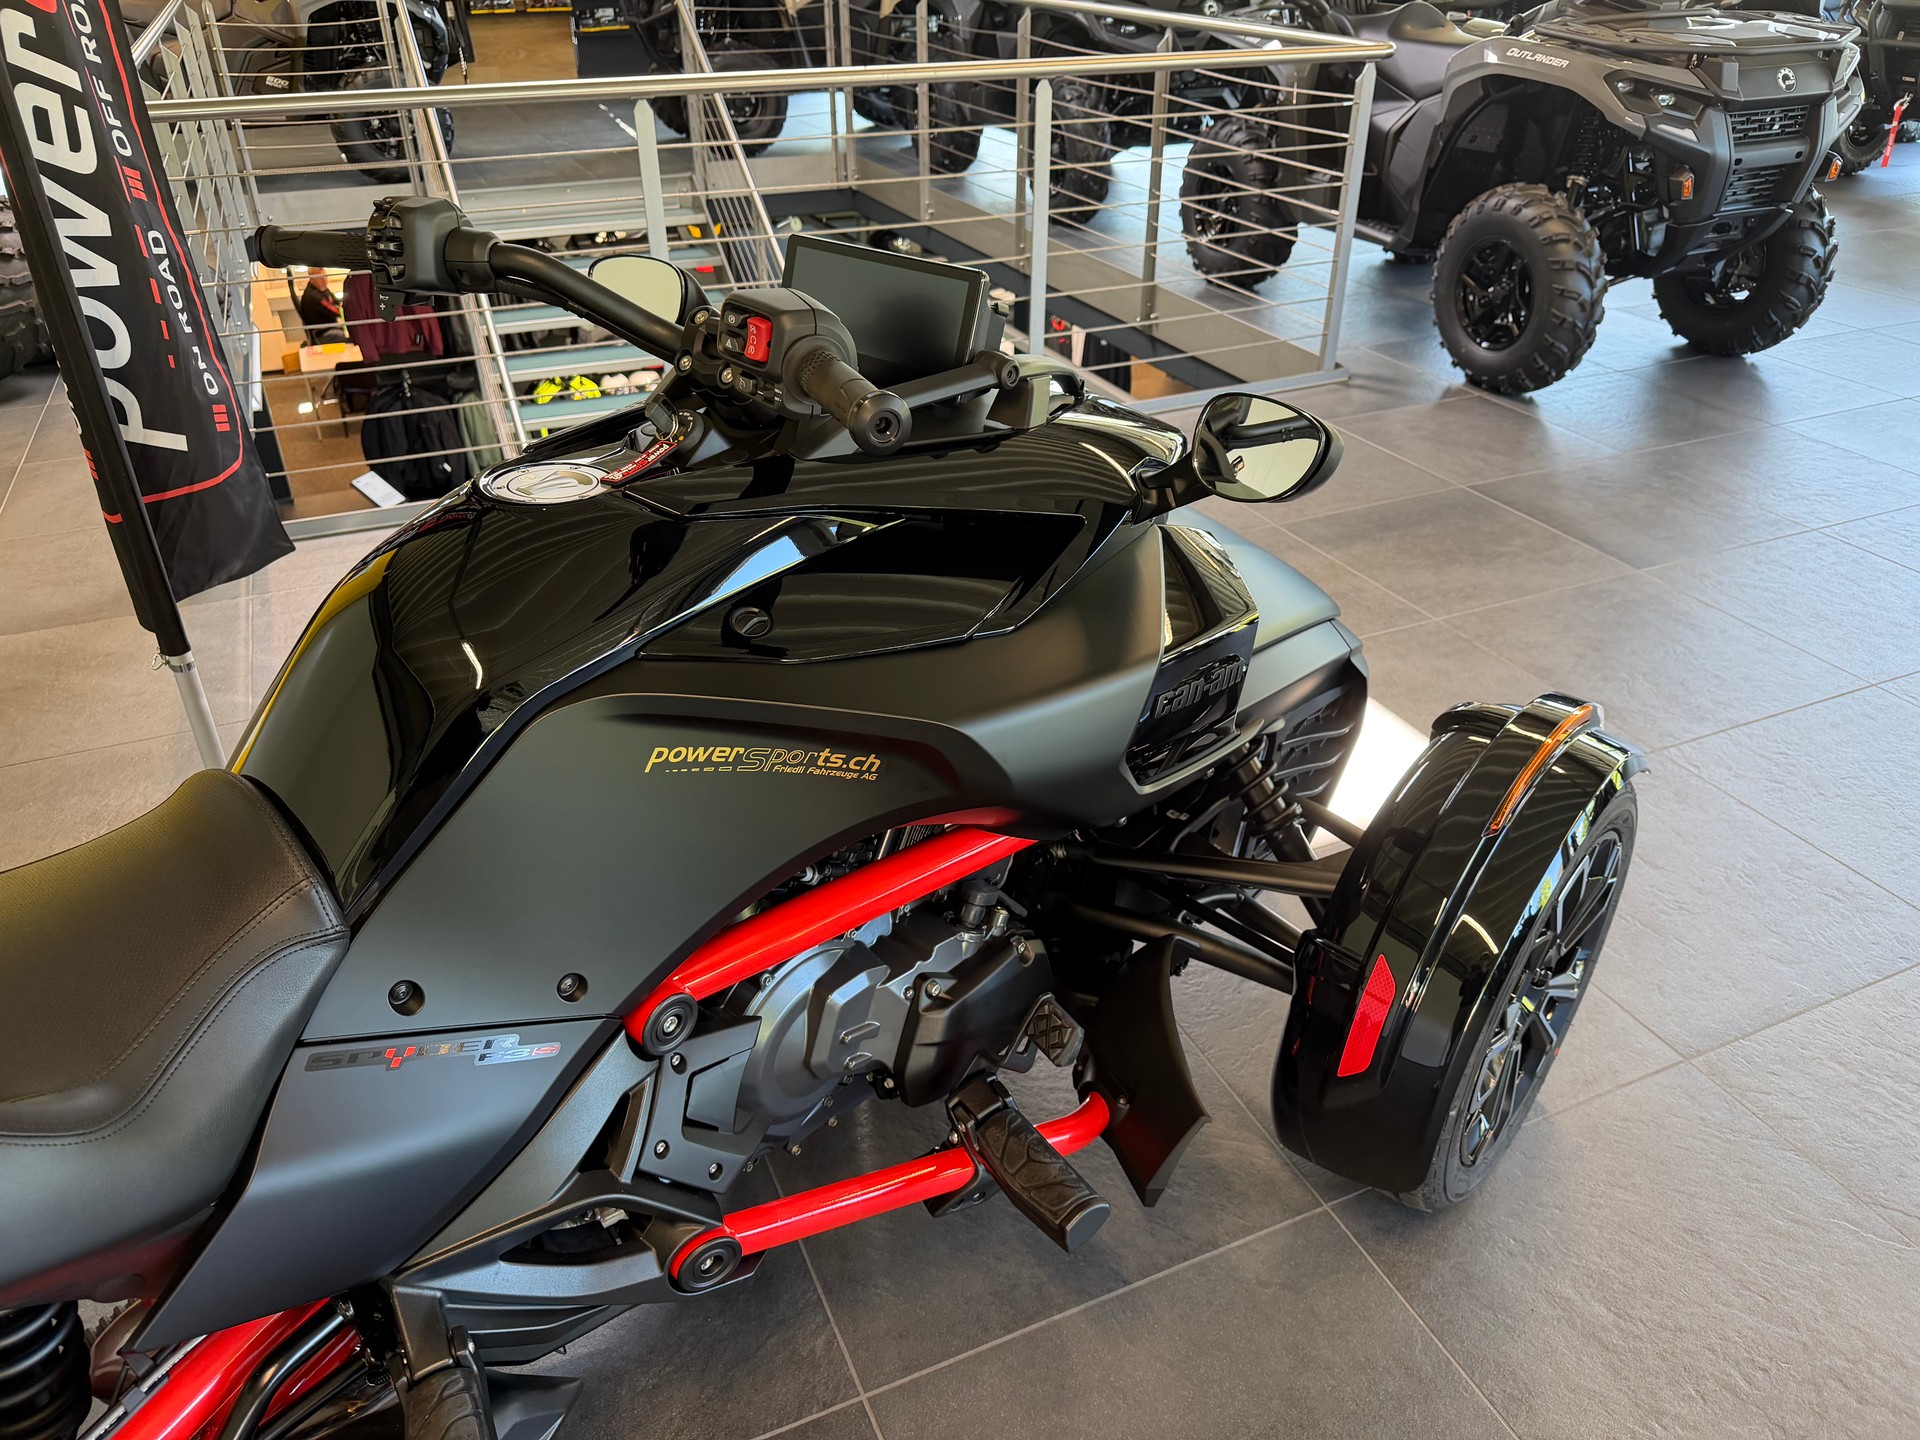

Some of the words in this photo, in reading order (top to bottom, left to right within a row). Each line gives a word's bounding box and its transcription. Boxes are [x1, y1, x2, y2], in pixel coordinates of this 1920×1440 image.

[70, 0, 103, 64] RO
[1505, 47, 1570, 69] OUTLANDER
[92, 75, 133, 157] OFF
[0, 8, 189, 452] power
[147, 230, 193, 334] ROAD
[772, 764, 806, 774] Friedli
[806, 767, 860, 780] Fahrzeuge
[860, 773, 879, 781] AG
